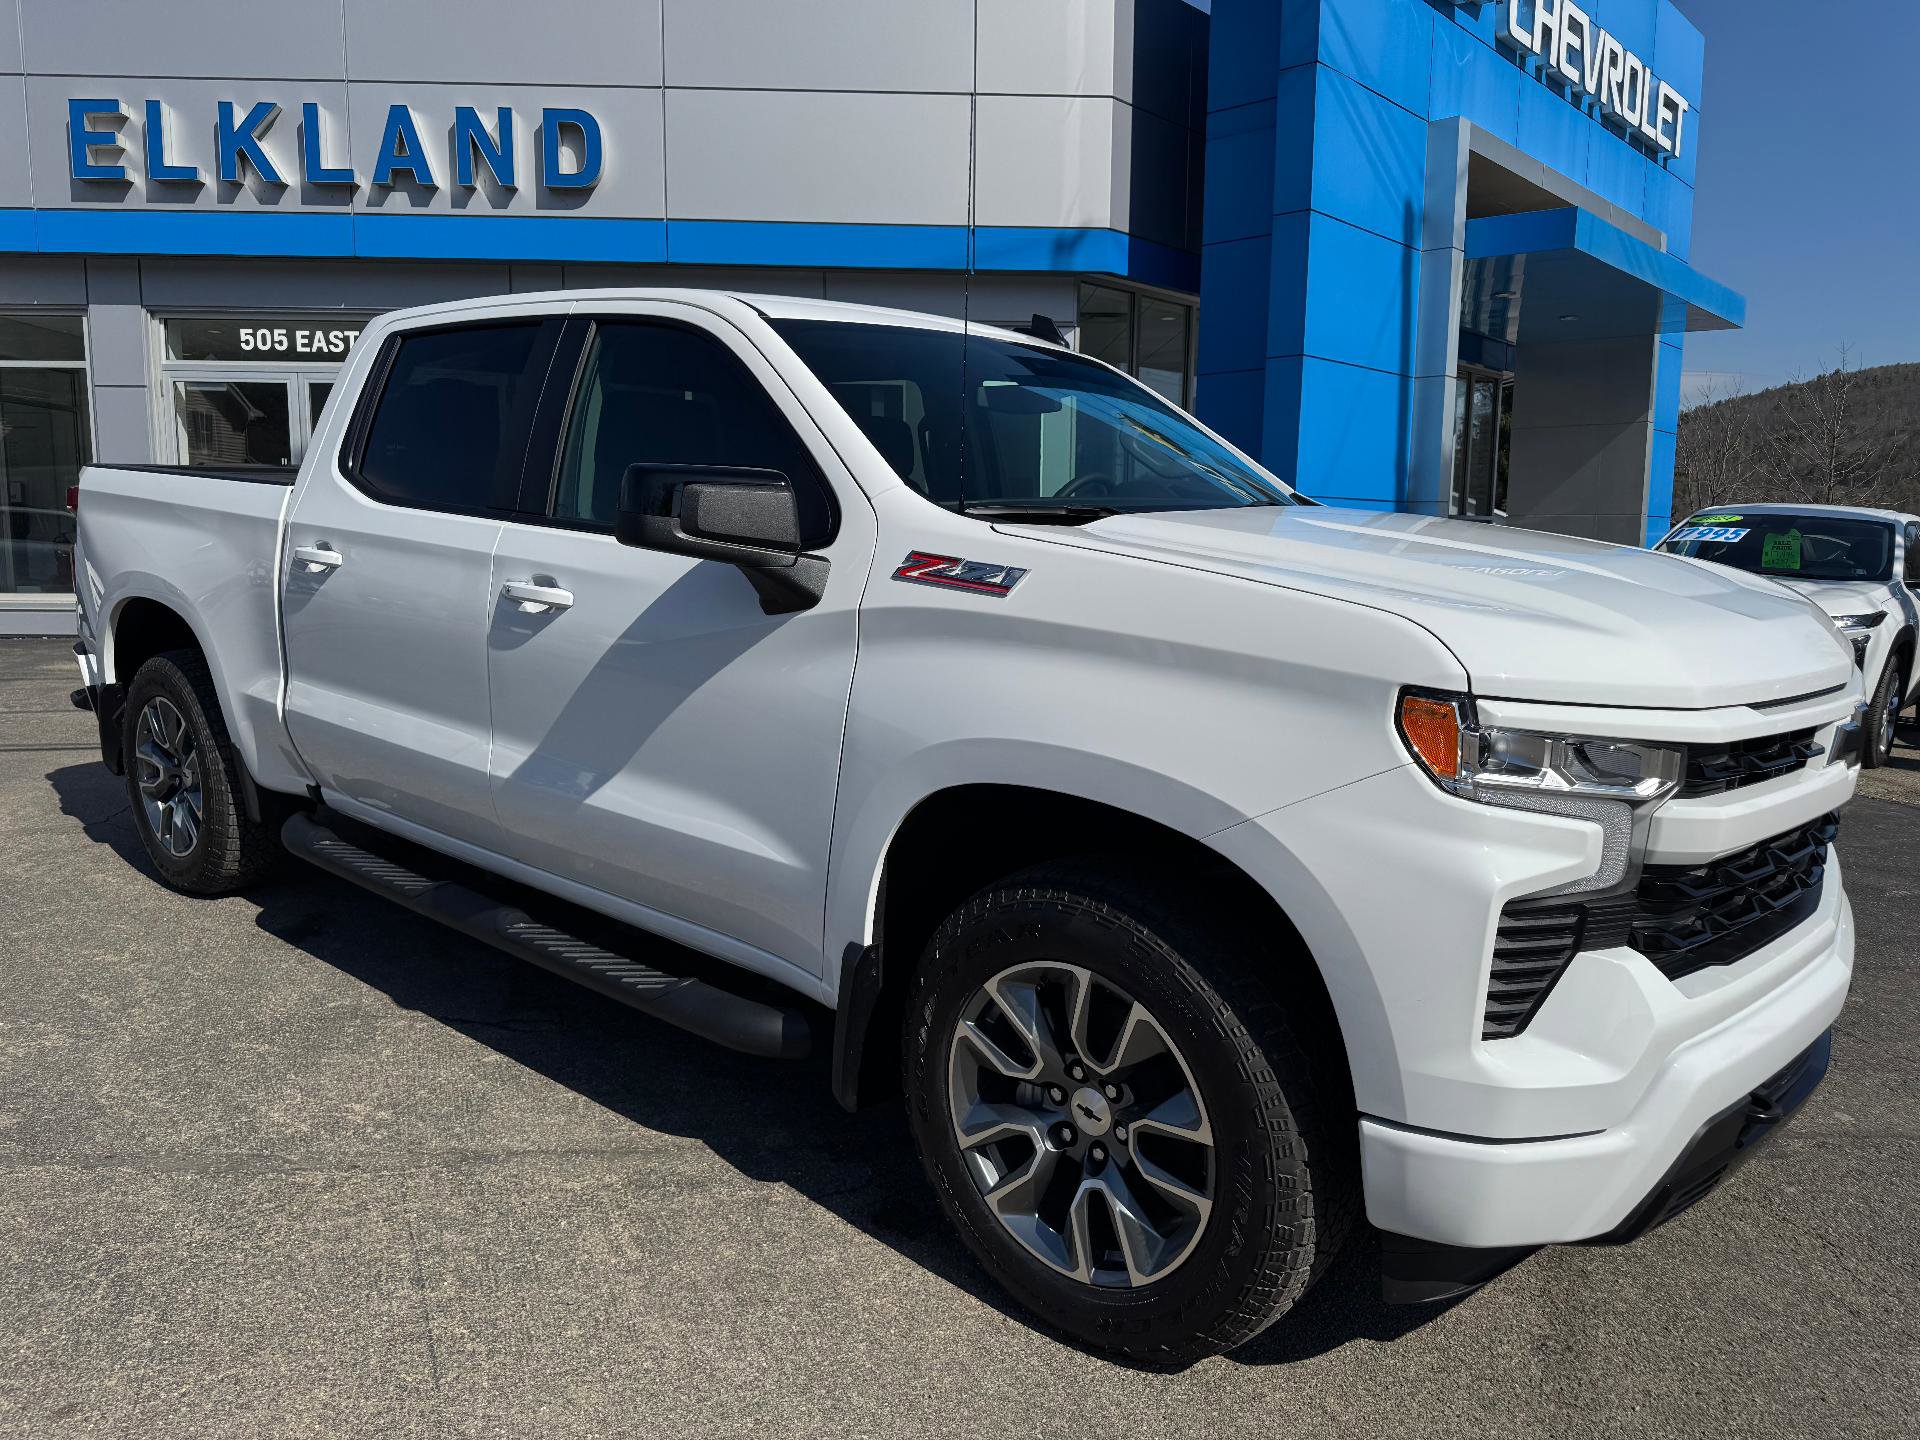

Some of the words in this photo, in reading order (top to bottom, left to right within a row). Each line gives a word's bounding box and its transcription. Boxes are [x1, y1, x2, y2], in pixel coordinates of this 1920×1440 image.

[1509, 0, 1688, 158] CHEVROLET
[68, 98, 606, 191] ELKLAND
[239, 328, 289, 351] 505
[295, 330, 360, 353] EAST
